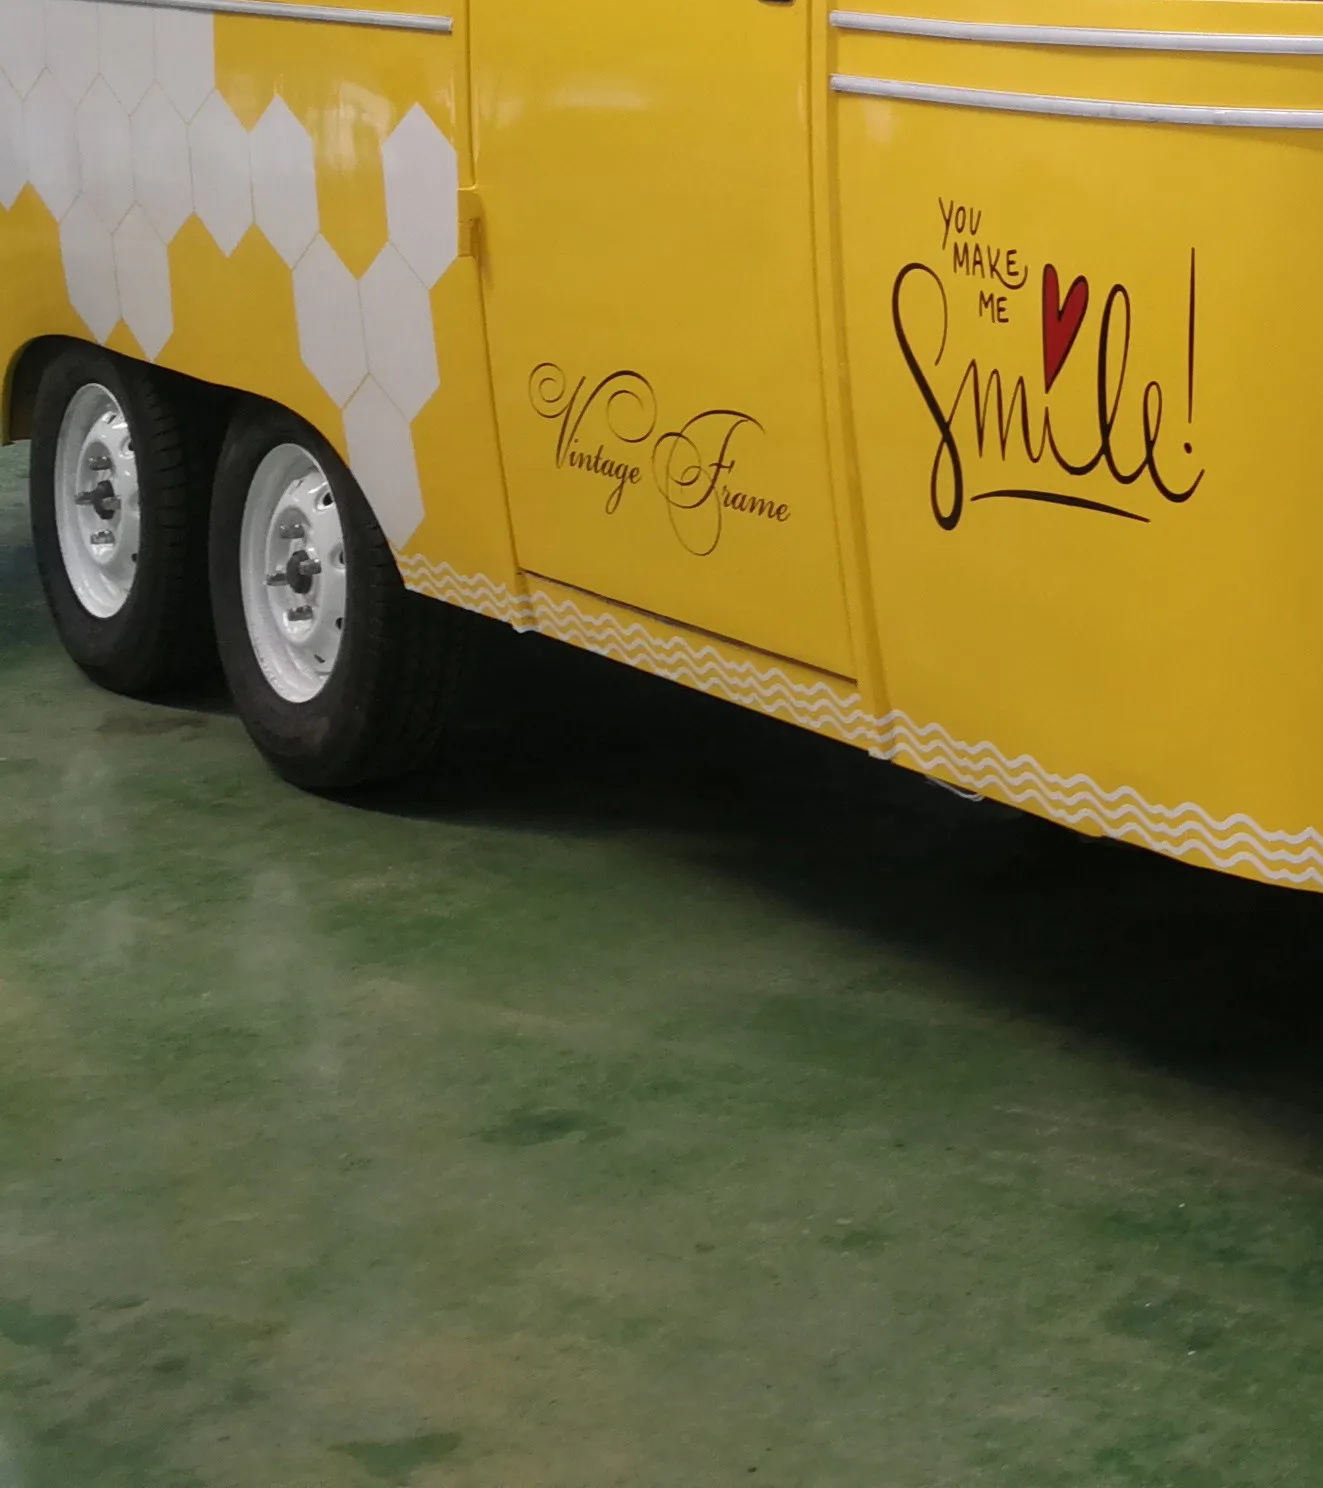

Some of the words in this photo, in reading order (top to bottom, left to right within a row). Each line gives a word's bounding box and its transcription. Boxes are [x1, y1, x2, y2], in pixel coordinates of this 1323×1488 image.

[938, 196, 984, 250] YOU
[952, 242, 1029, 289] MAKE
[978, 289, 1010, 324] ME
[528, 362, 657, 515] Vintage
[651, 408, 791, 557] Frame
